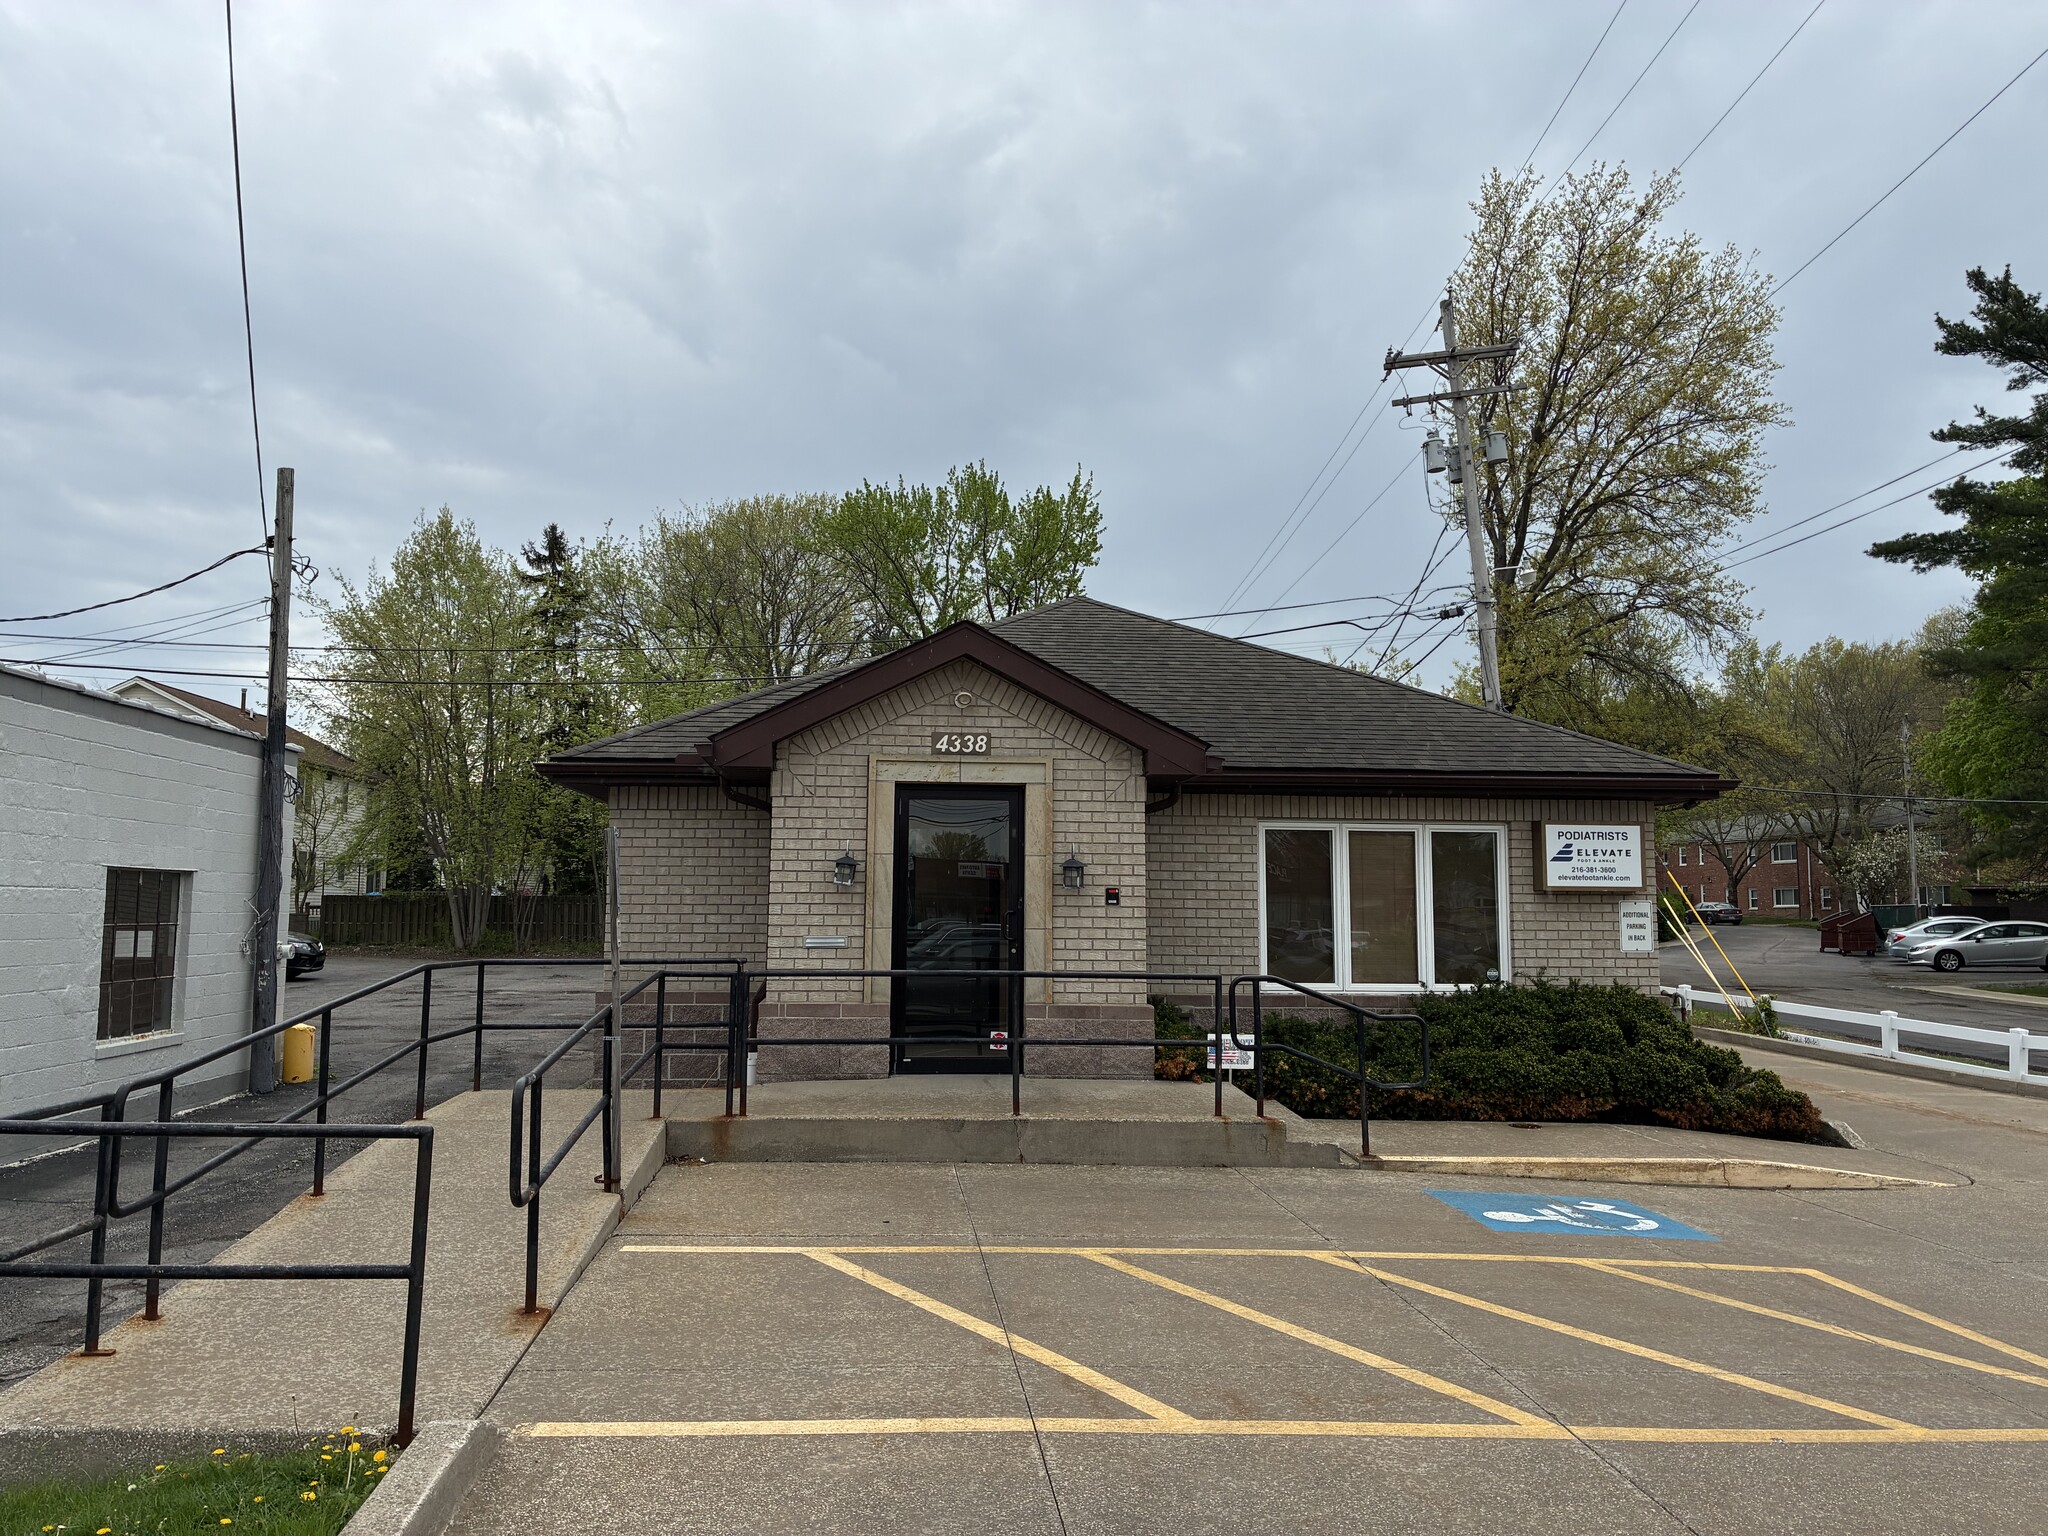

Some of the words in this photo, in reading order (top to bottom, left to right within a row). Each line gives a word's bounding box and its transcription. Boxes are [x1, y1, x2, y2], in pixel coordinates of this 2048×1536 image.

[935, 734, 988, 753] 4338
[1557, 831, 1629, 841] PODIATRISTS
[1577, 848, 1632, 857] ELEVATE
[1557, 874, 1631, 882] elevatefootankle.com
[1622, 911, 1650, 919] ADDITIONAL
[1634, 934, 1646, 942] BACK
